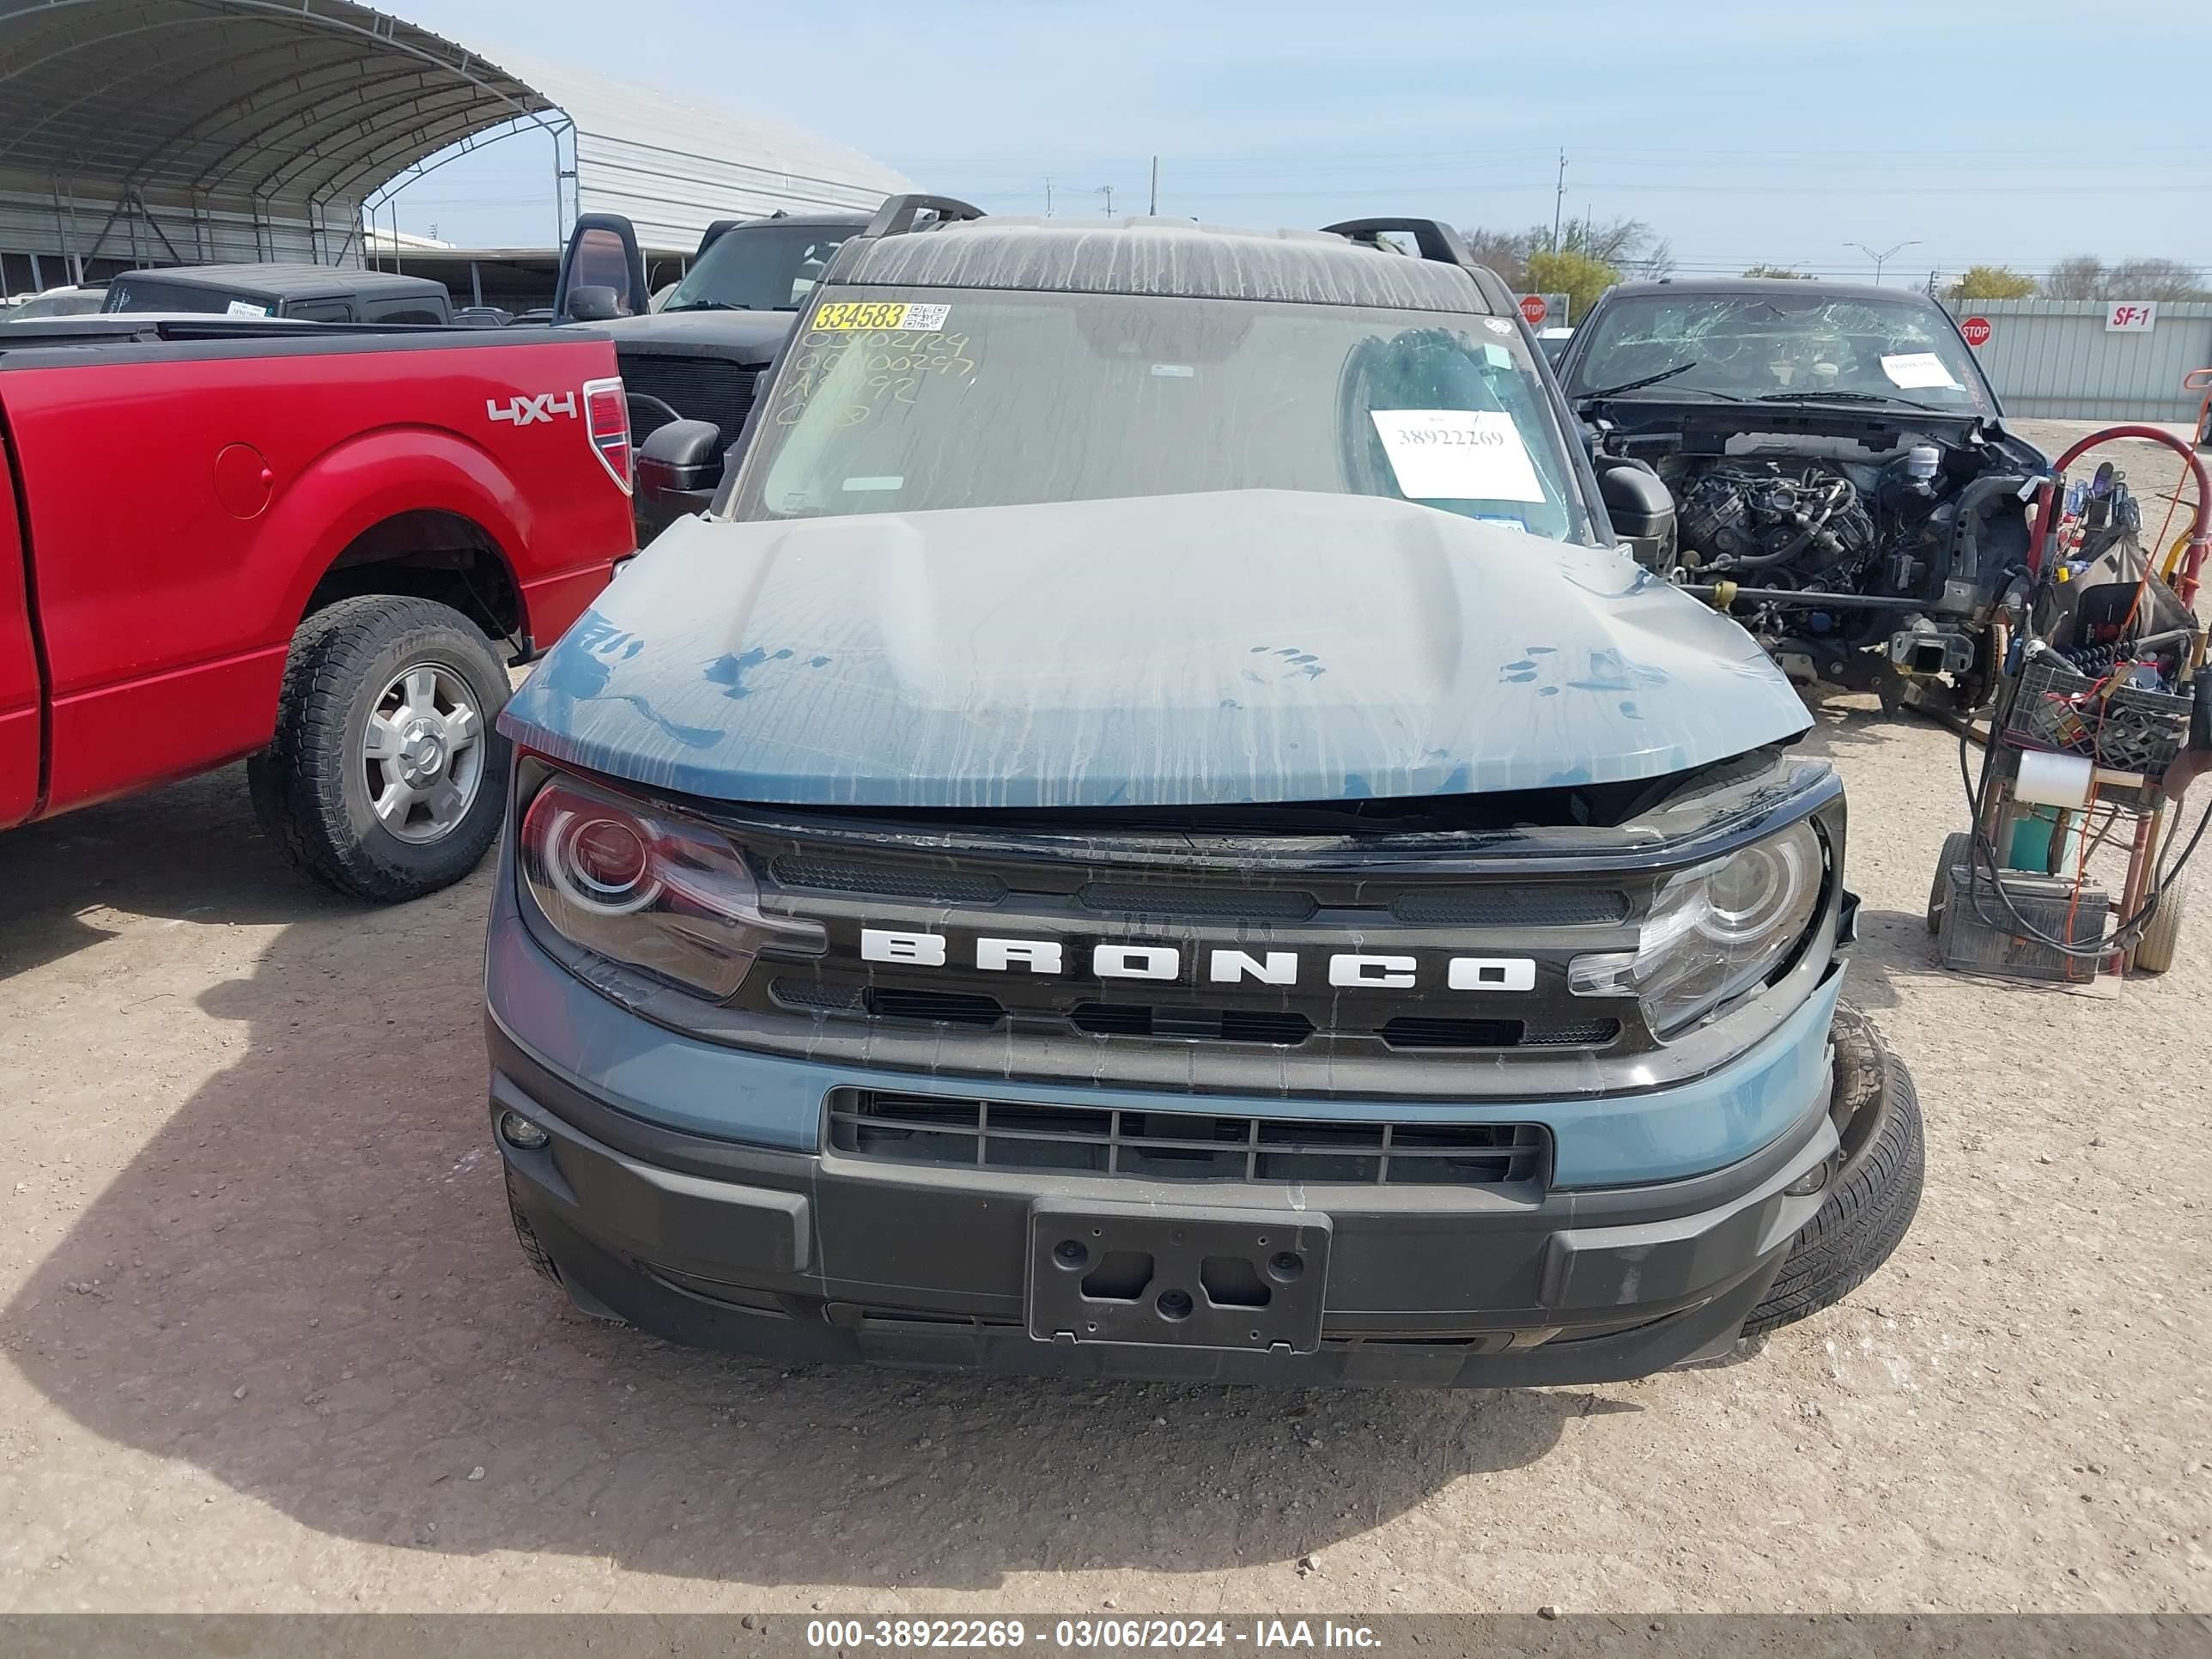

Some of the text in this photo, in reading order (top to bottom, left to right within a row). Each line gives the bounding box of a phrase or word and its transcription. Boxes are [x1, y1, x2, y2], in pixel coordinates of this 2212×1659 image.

[816, 304, 905, 328] 334583
[1521, 304, 1545, 316] STOP
[2113, 307, 2150, 325] SF-1
[1963, 325, 1990, 337] STOP
[1396, 429, 1504, 446] 38922269
[860, 928, 1537, 992] BRONCO
